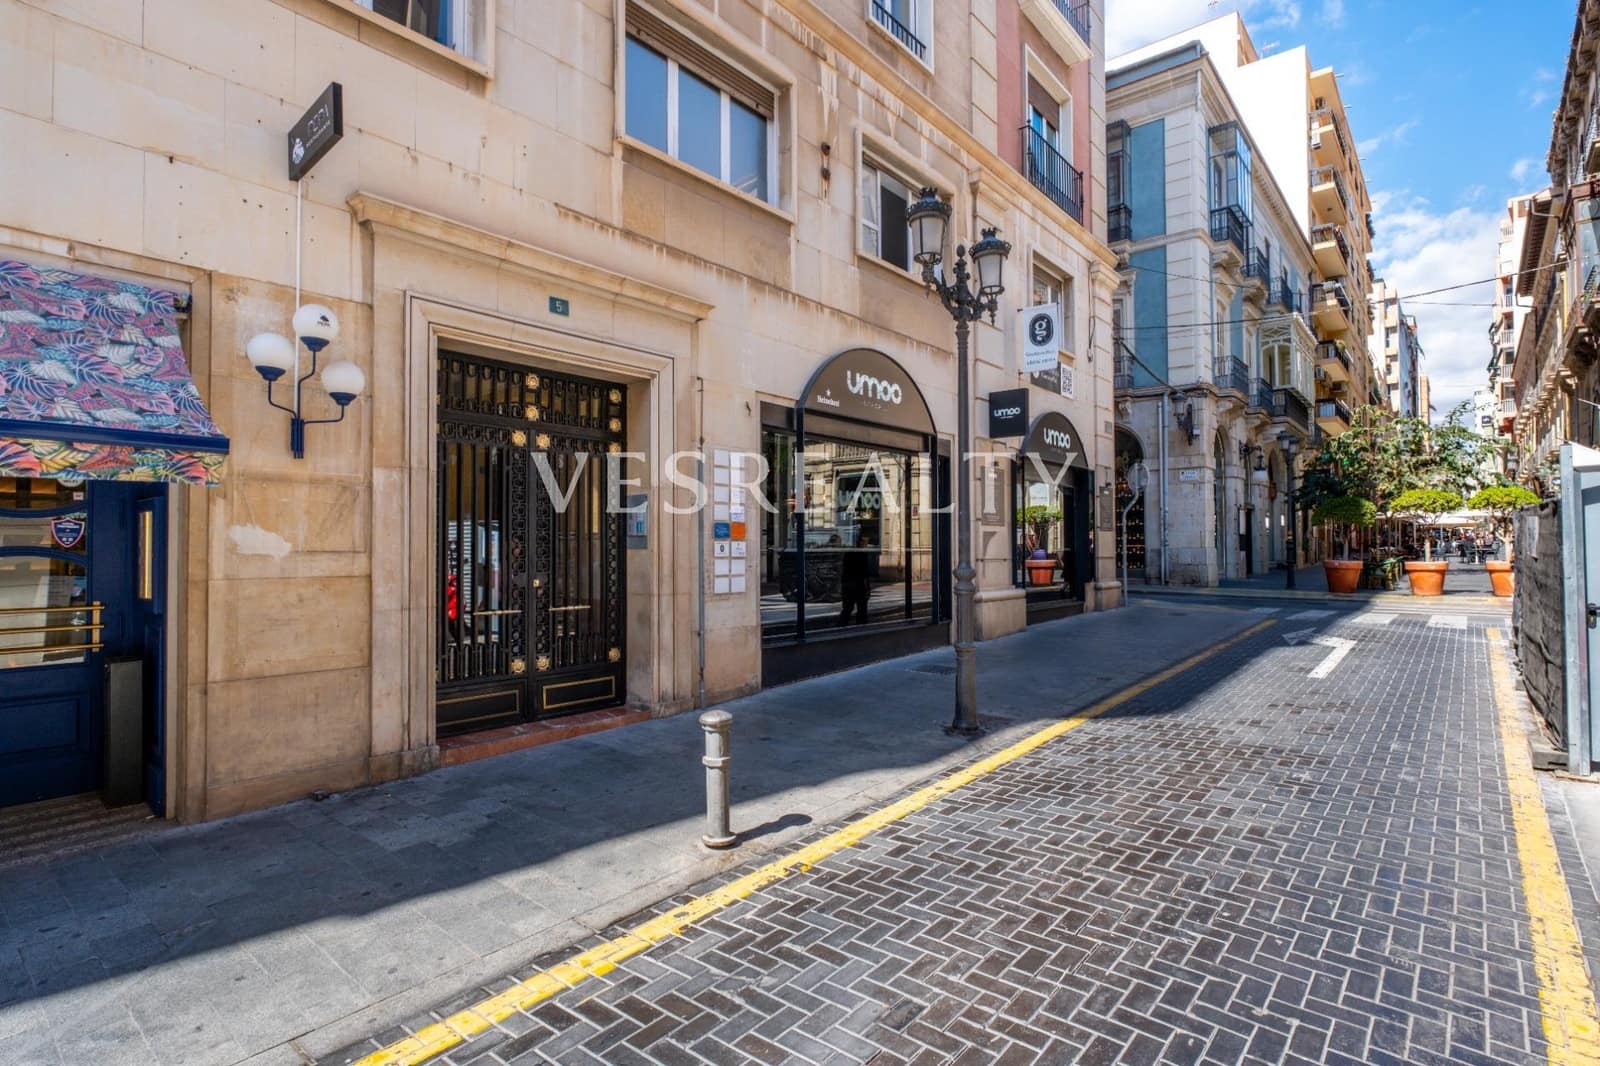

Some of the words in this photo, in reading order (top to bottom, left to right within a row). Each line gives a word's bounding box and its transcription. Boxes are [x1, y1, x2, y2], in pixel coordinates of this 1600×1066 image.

[556, 300, 562, 313] 5
[847, 369, 902, 405] umoo
[993, 407, 1021, 417] umoo
[1043, 427, 1071, 449] umoo
